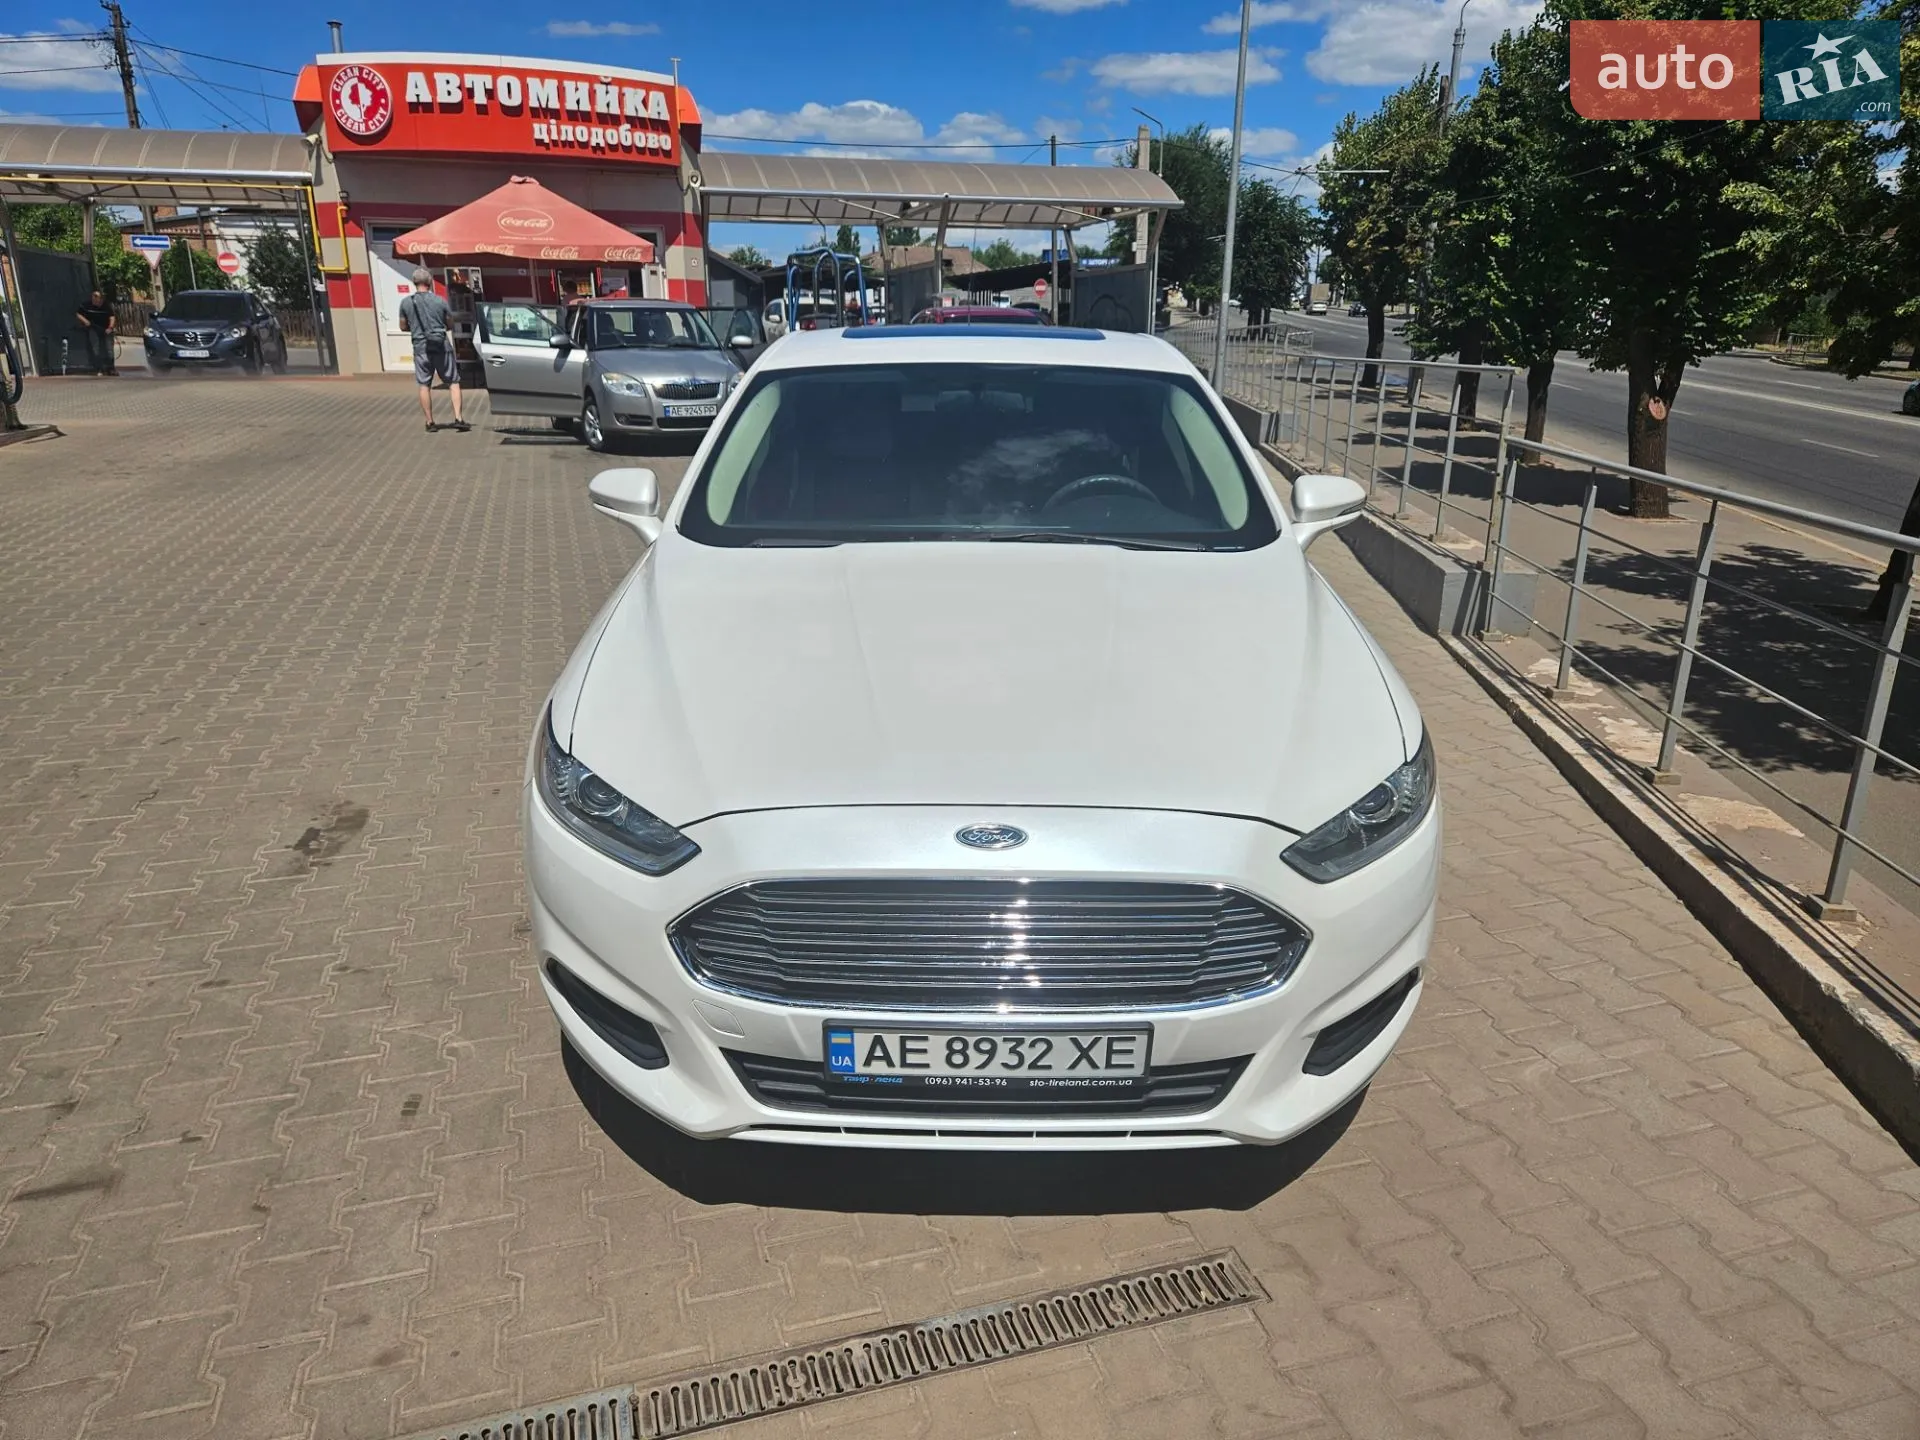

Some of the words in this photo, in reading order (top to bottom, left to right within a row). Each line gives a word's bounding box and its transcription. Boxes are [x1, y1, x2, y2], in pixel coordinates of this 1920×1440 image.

[332, 66, 360, 92] CLEAN
[362, 68, 385, 91] CITY
[405, 71, 671, 121] АВТОМИЙКА
[336, 108, 366, 132] CLEAN
[368, 106, 387, 131] CITY
[532, 118, 673, 151] цілодобово
[671, 406, 683, 416] AE
[684, 406, 703, 416] 9245
[703, 405, 715, 415] PP
[832, 1056, 852, 1066] UA
[862, 1034, 931, 1069] AE
[945, 1036, 1054, 1070] 8932
[1066, 1036, 1137, 1070] XE
[924, 1077, 952, 1086] (096)
[955, 1078, 1008, 1087] 941-53-96
[1029, 1079, 1133, 1087] sto-tireland.com.ua
